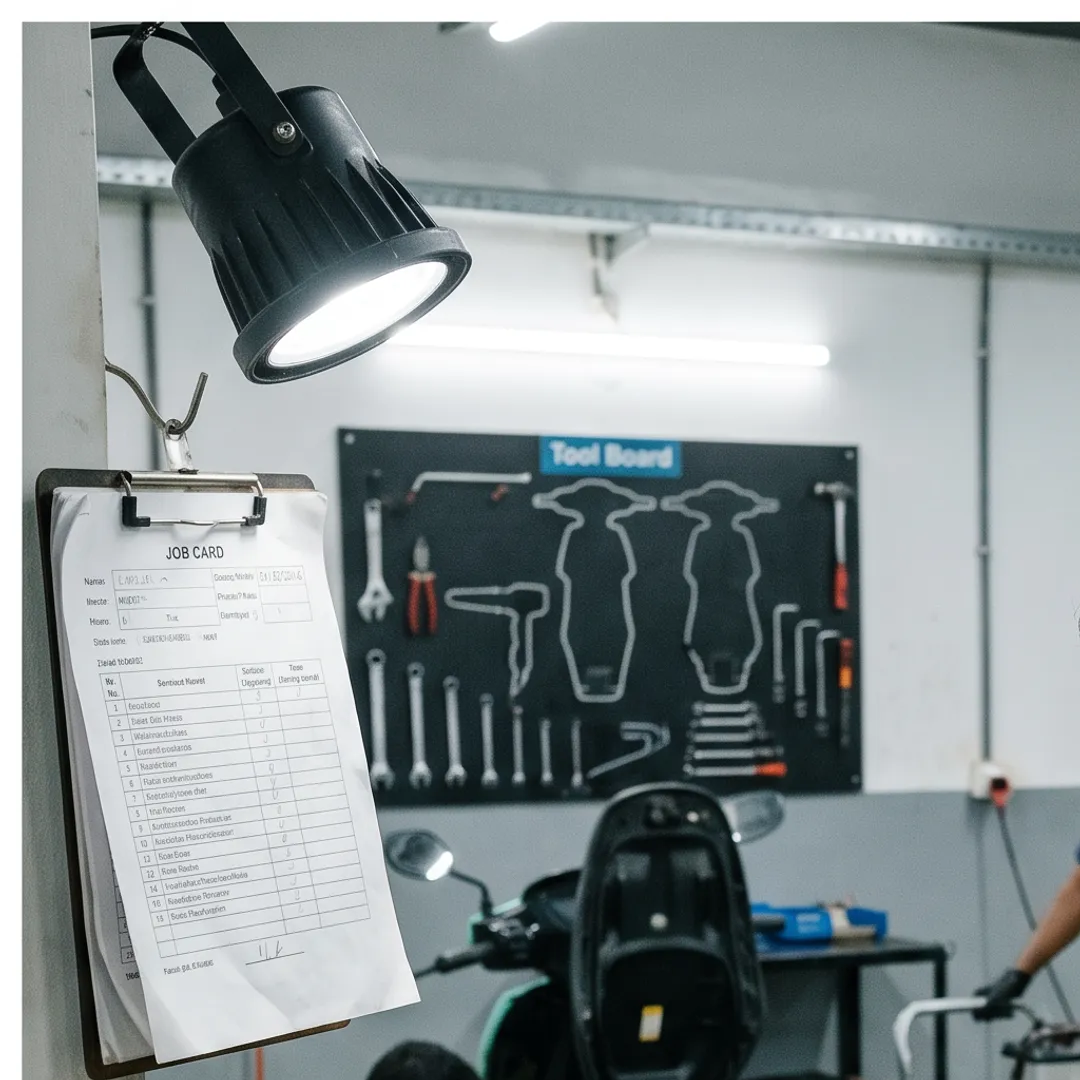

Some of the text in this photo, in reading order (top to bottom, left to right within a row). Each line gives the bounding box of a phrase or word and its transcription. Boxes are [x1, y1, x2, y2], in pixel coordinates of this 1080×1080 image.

[549, 440, 674, 469] Tool Board
[166, 545, 224, 560] JOB CARD
